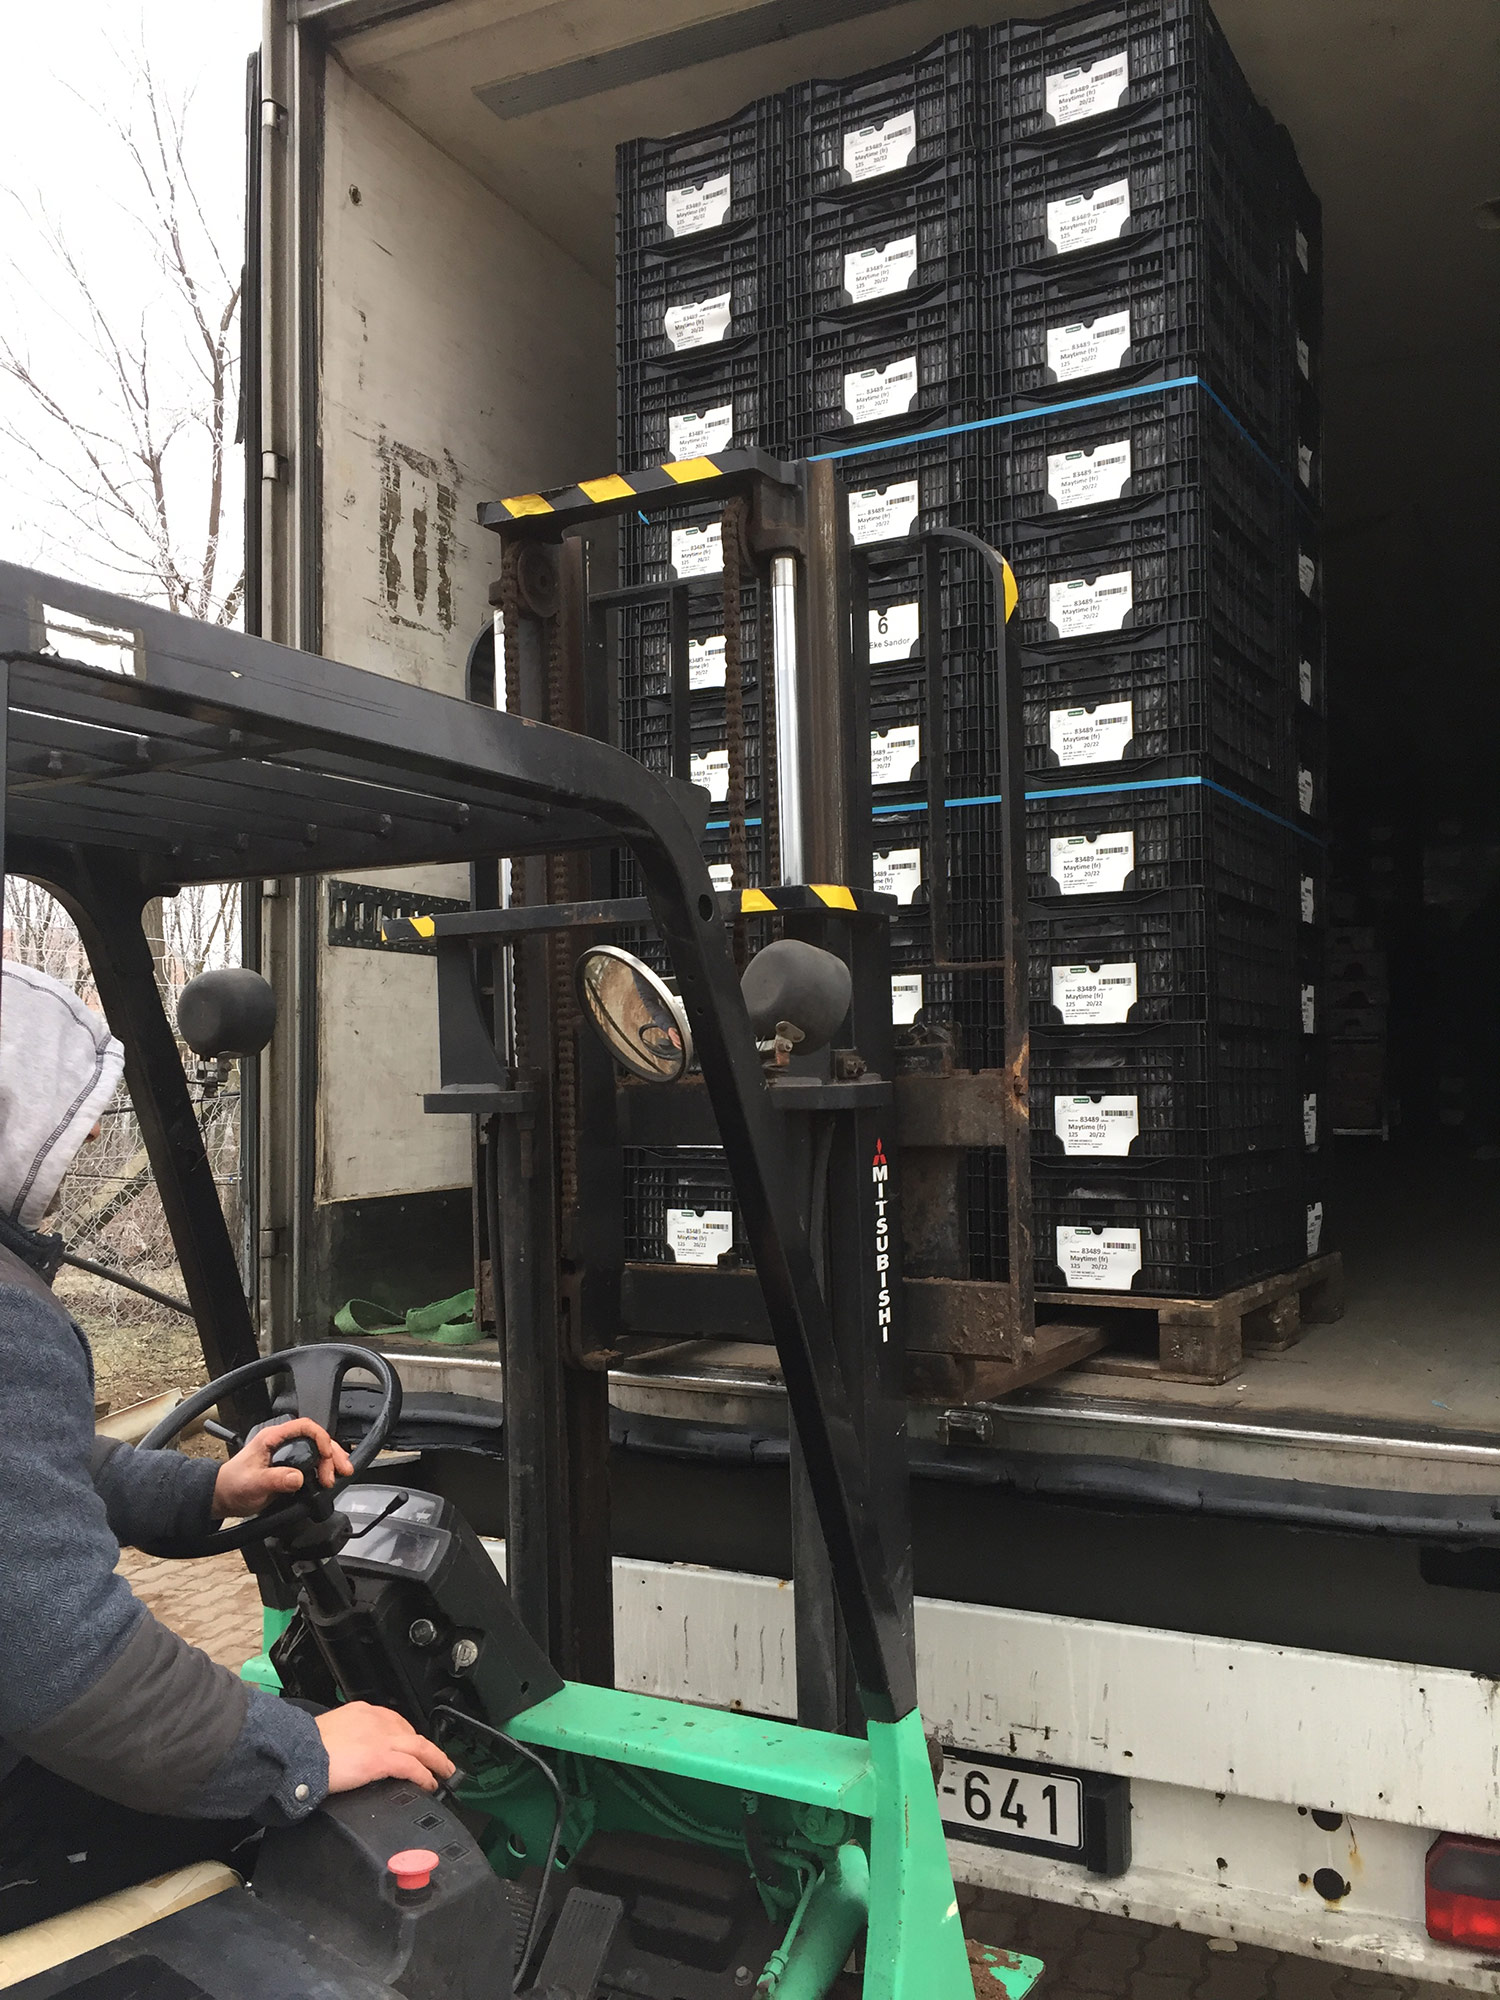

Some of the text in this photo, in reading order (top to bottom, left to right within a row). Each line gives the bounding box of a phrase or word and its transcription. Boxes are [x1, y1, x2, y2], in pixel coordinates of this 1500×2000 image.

[1070, 85, 1090, 95] 83489
[1059, 89, 1096, 105] Maytime (fr)
[1079, 97, 1095, 106] 20/22
[1072, 213, 1091, 222] 83489
[1060, 218, 1098, 232] Maytime (fr)
[1081, 226, 1097, 234] 20/22
[1072, 341, 1091, 350] 83489
[1060, 347, 1098, 360] Maytime (fr)
[1081, 355, 1097, 363] 20/22
[1073, 469, 1092, 478] 83489
[1061, 475, 1099, 487] Maytime (fr)
[1082, 483, 1098, 491] 20/22
[1074, 599, 1093, 607] 83489
[1062, 607, 1089, 615] Maytime
[878, 617, 889, 635] 6
[884, 638, 910, 647] Sandor
[1075, 727, 1094, 735] 83489
[1063, 733, 1101, 743] Maytime (fr)
[1084, 741, 1100, 749] 20/22
[1063, 862, 1102, 872] Maytime (fr)
[1077, 985, 1097, 993] 83489
[1065, 992, 1104, 1001] Maytime (fr)
[1068, 1124, 1096, 1132] Maytime
[873, 1165, 891, 1343] MITSUBISHI
[1099, 1256, 1109, 1264] (fr)
